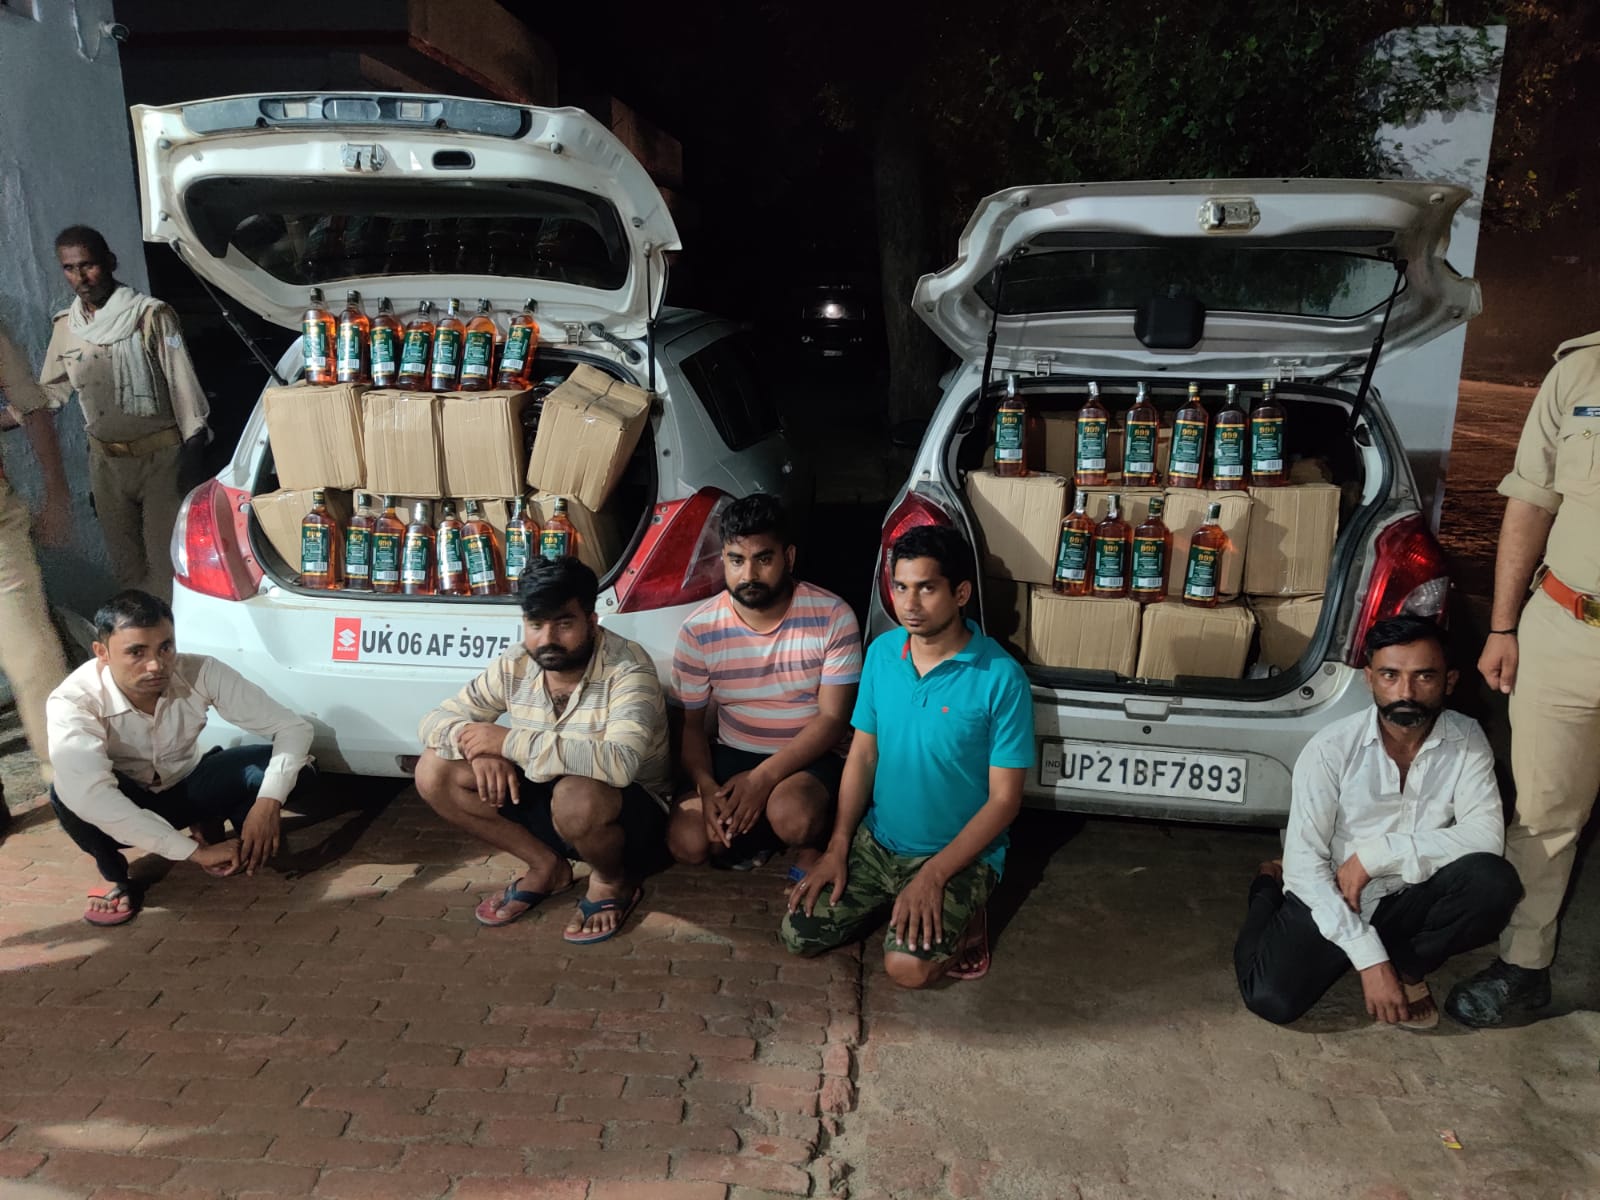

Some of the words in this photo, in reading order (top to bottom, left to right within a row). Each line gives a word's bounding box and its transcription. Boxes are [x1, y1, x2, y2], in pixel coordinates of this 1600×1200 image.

[362, 630, 393, 654] UK
[398, 632, 422, 655] 06
[426, 633, 454, 656] AF
